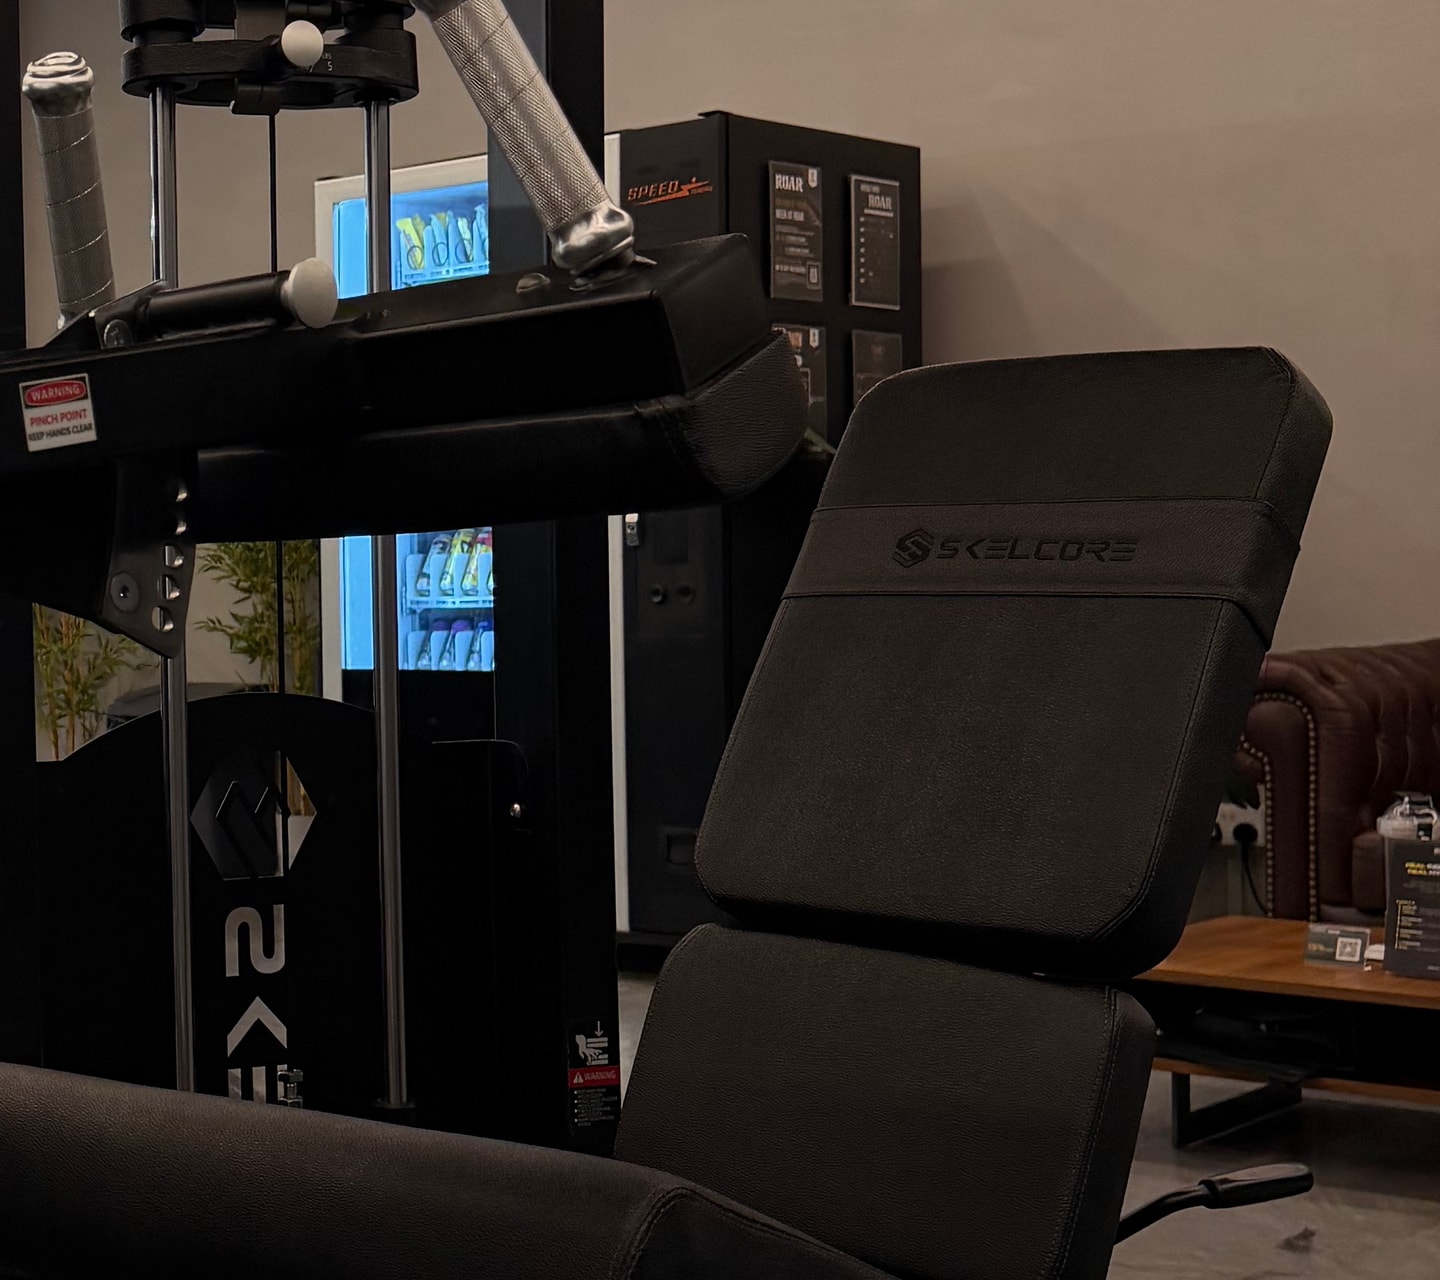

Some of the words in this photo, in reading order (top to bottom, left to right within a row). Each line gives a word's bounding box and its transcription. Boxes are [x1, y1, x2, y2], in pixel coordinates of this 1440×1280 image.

[327, 60, 333, 71] 5
[627, 180, 679, 201] SPEED
[775, 173, 804, 193] ROAR
[868, 194, 892, 210] ROAR
[30, 384, 81, 402] WARNING
[30, 414, 59, 427] PINCH
[60, 408, 88, 423] POINT
[28, 431, 45, 441] KEEP
[46, 426, 72, 439] HANDS
[72, 422, 94, 434] CLEAR
[935, 537, 1138, 562] SKELCORE
